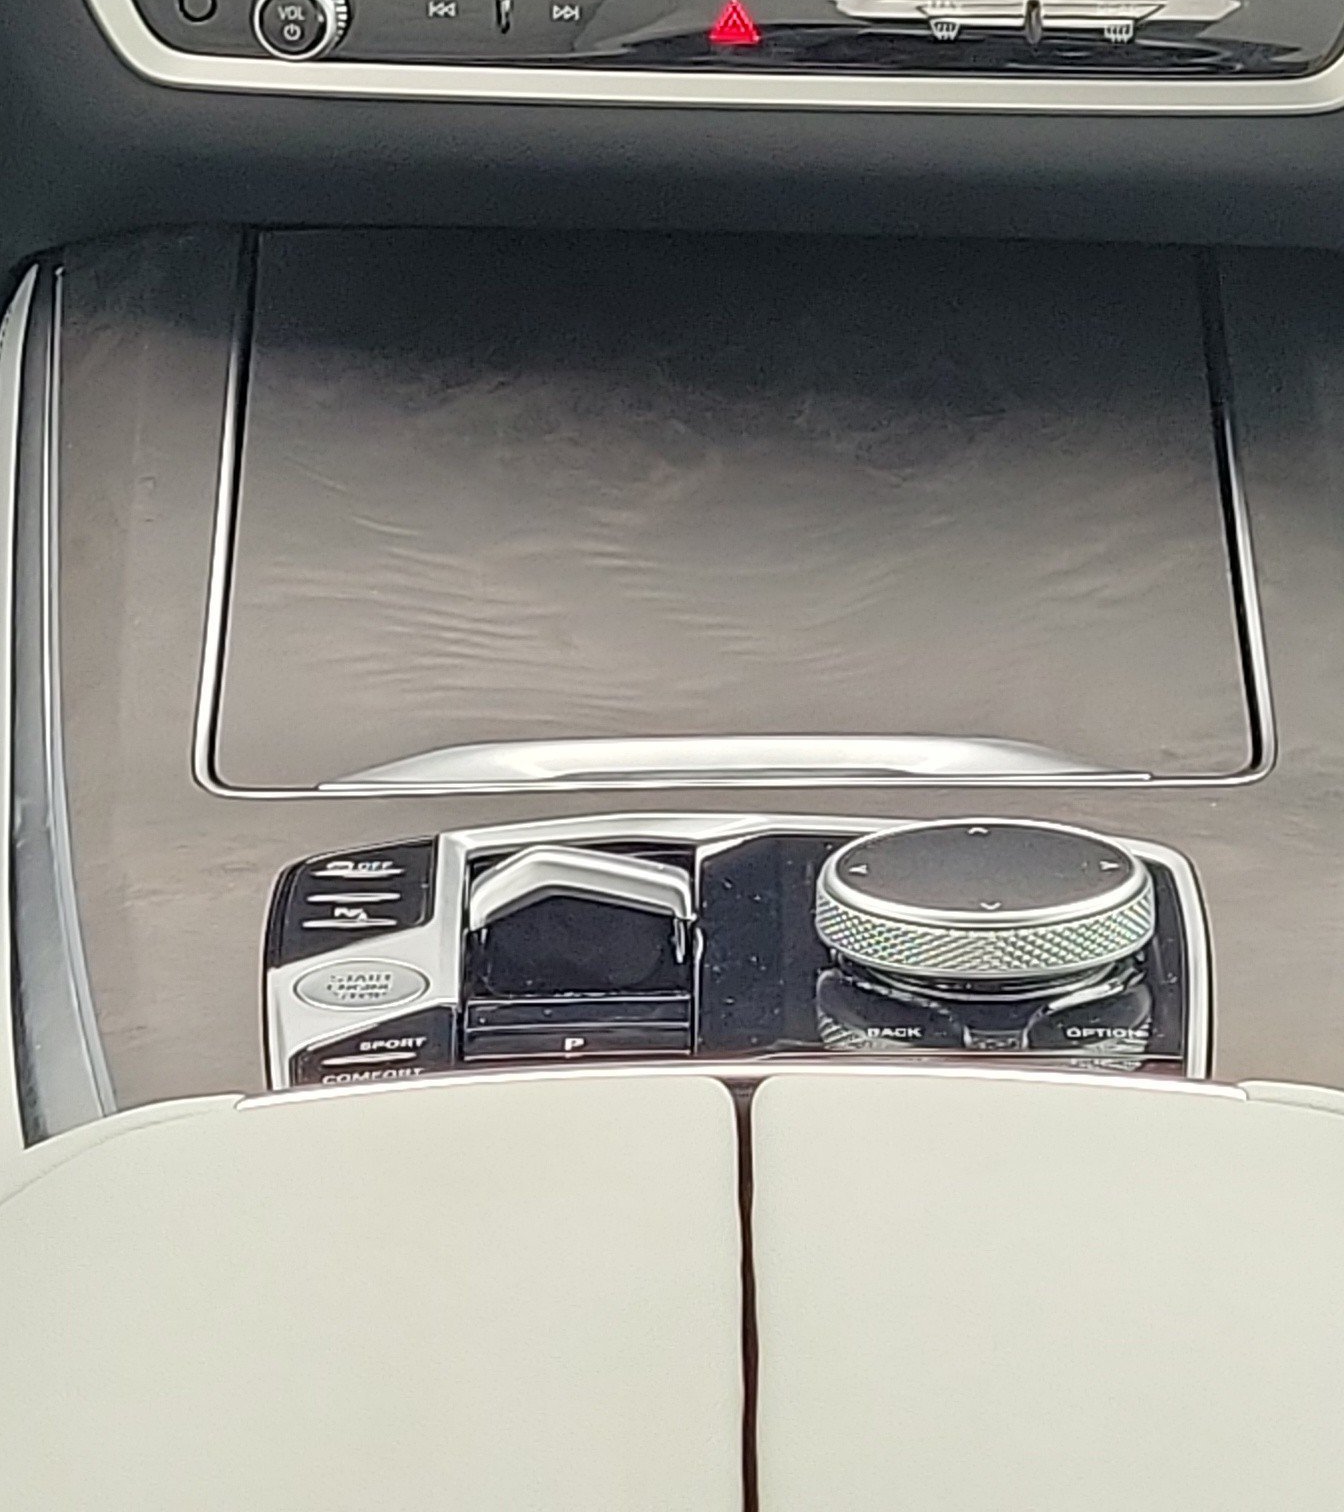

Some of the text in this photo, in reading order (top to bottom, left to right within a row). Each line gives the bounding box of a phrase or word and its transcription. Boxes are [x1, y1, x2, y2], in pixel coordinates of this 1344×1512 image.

[277, 5, 306, 21] VOL
[359, 1037, 427, 1052] SPORT
[564, 1037, 585, 1051] P
